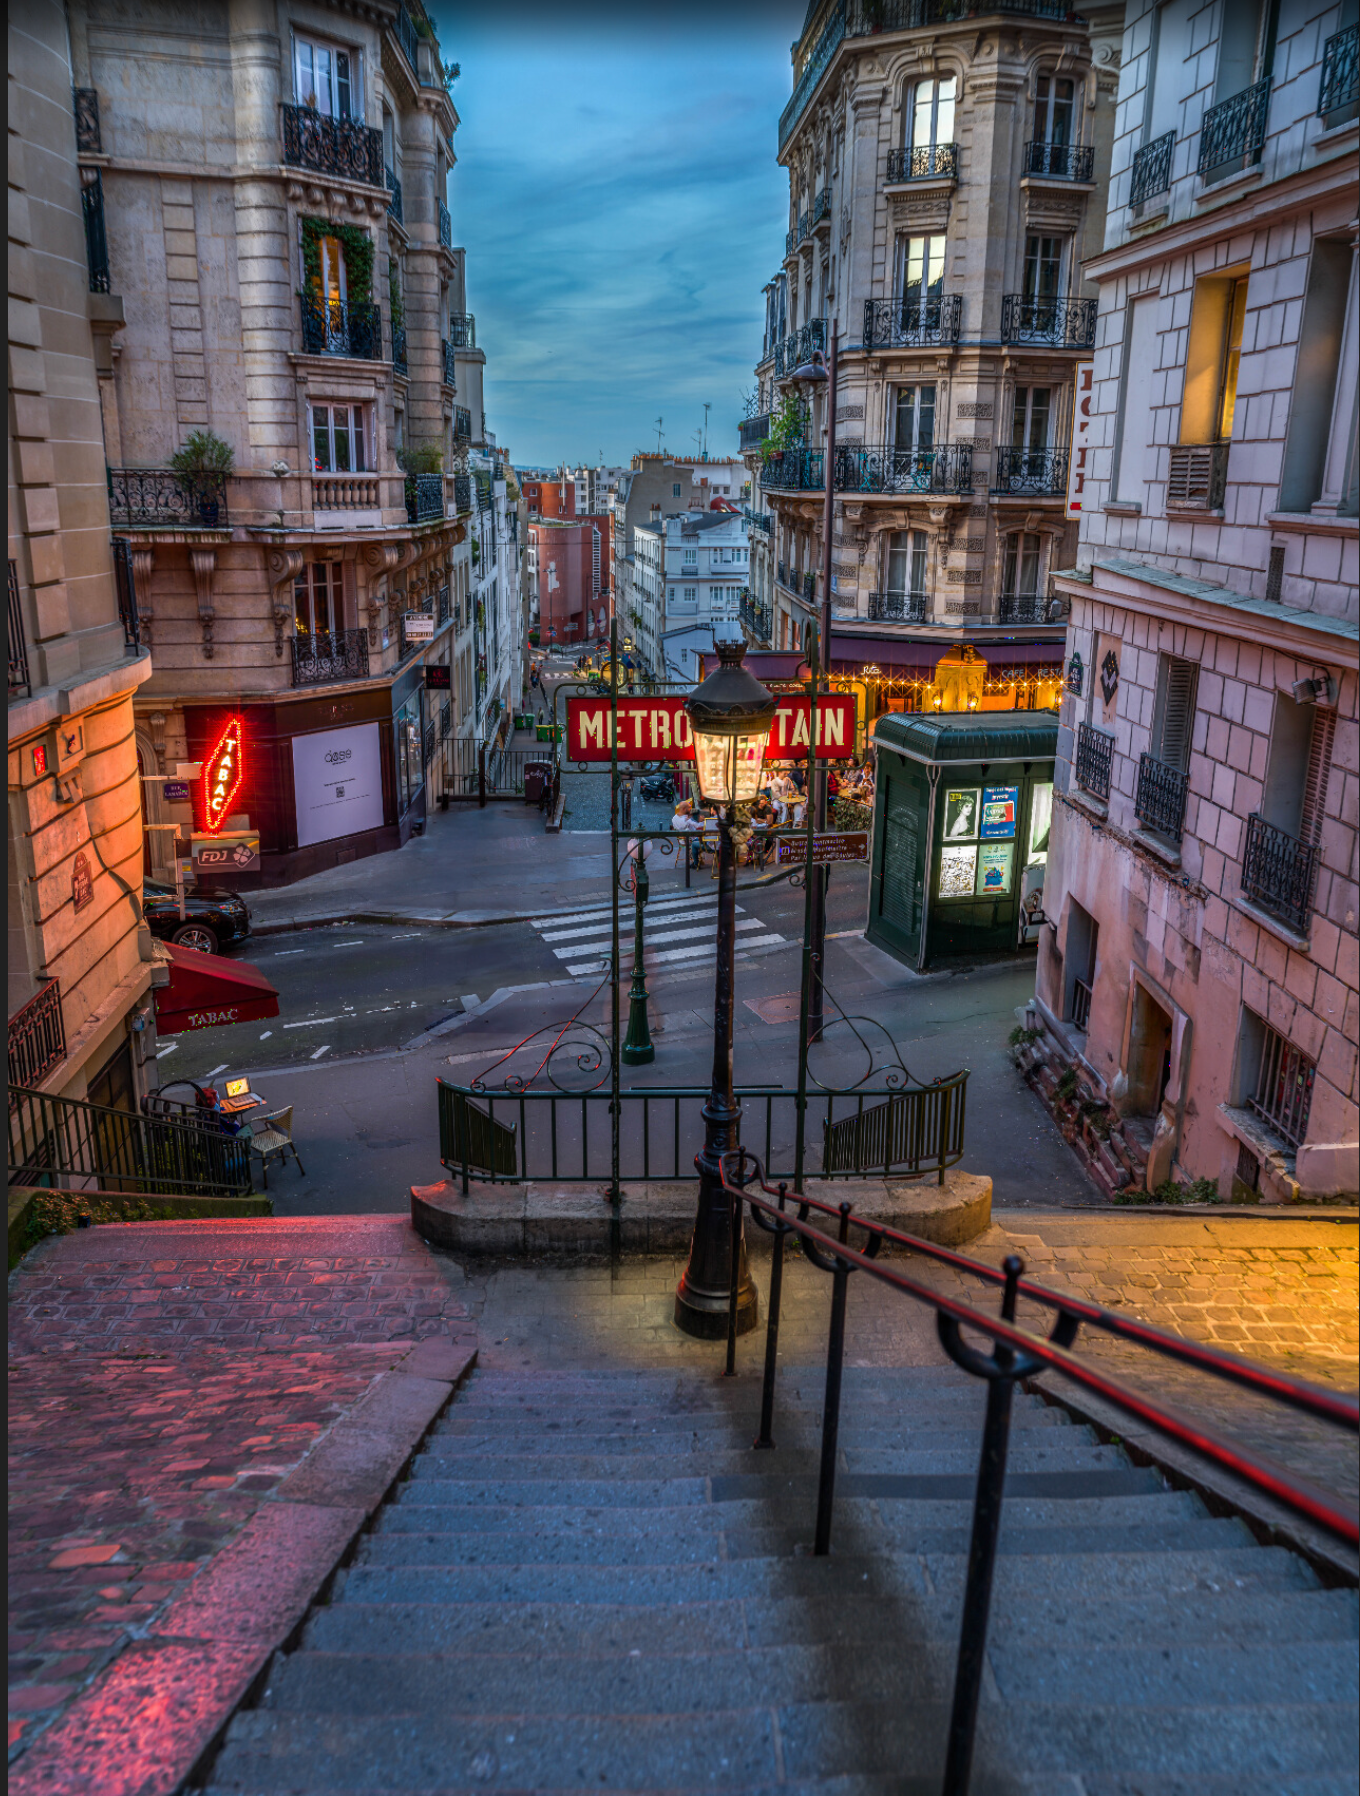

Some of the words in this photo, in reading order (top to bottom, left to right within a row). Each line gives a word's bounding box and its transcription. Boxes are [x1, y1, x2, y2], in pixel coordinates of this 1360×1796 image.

[860, 664, 882, 675] Rita
[579, 708, 844, 749] METROTAIN
[211, 739, 237, 810] TABAC
[202, 850, 229, 862] FDJ
[188, 1008, 238, 1026] TABAC
